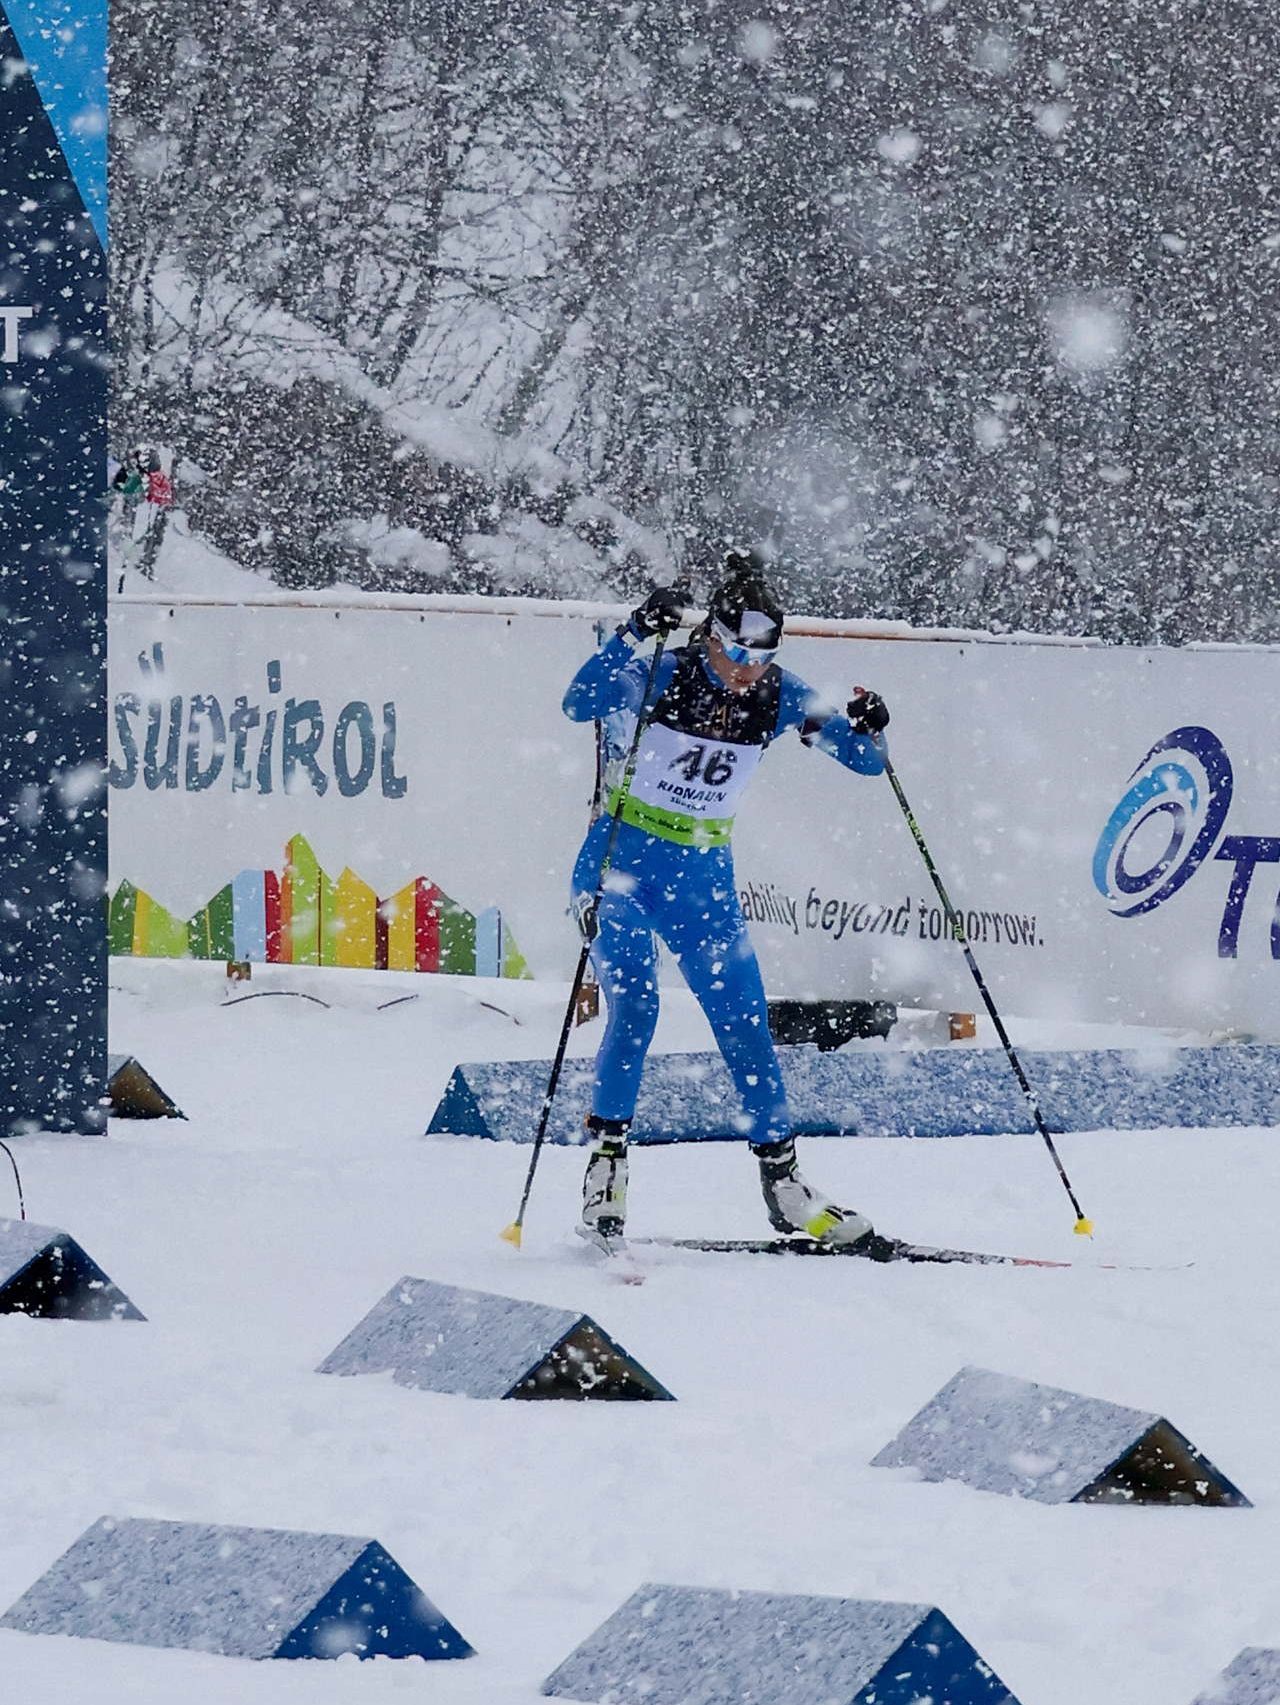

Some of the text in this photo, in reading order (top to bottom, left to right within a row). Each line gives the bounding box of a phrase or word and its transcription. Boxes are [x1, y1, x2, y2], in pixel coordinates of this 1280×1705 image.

[667, 743, 738, 786] 46
[656, 779, 727, 803] RIDNAUN
[740, 880, 1045, 948] ability beyond tomorrow.
